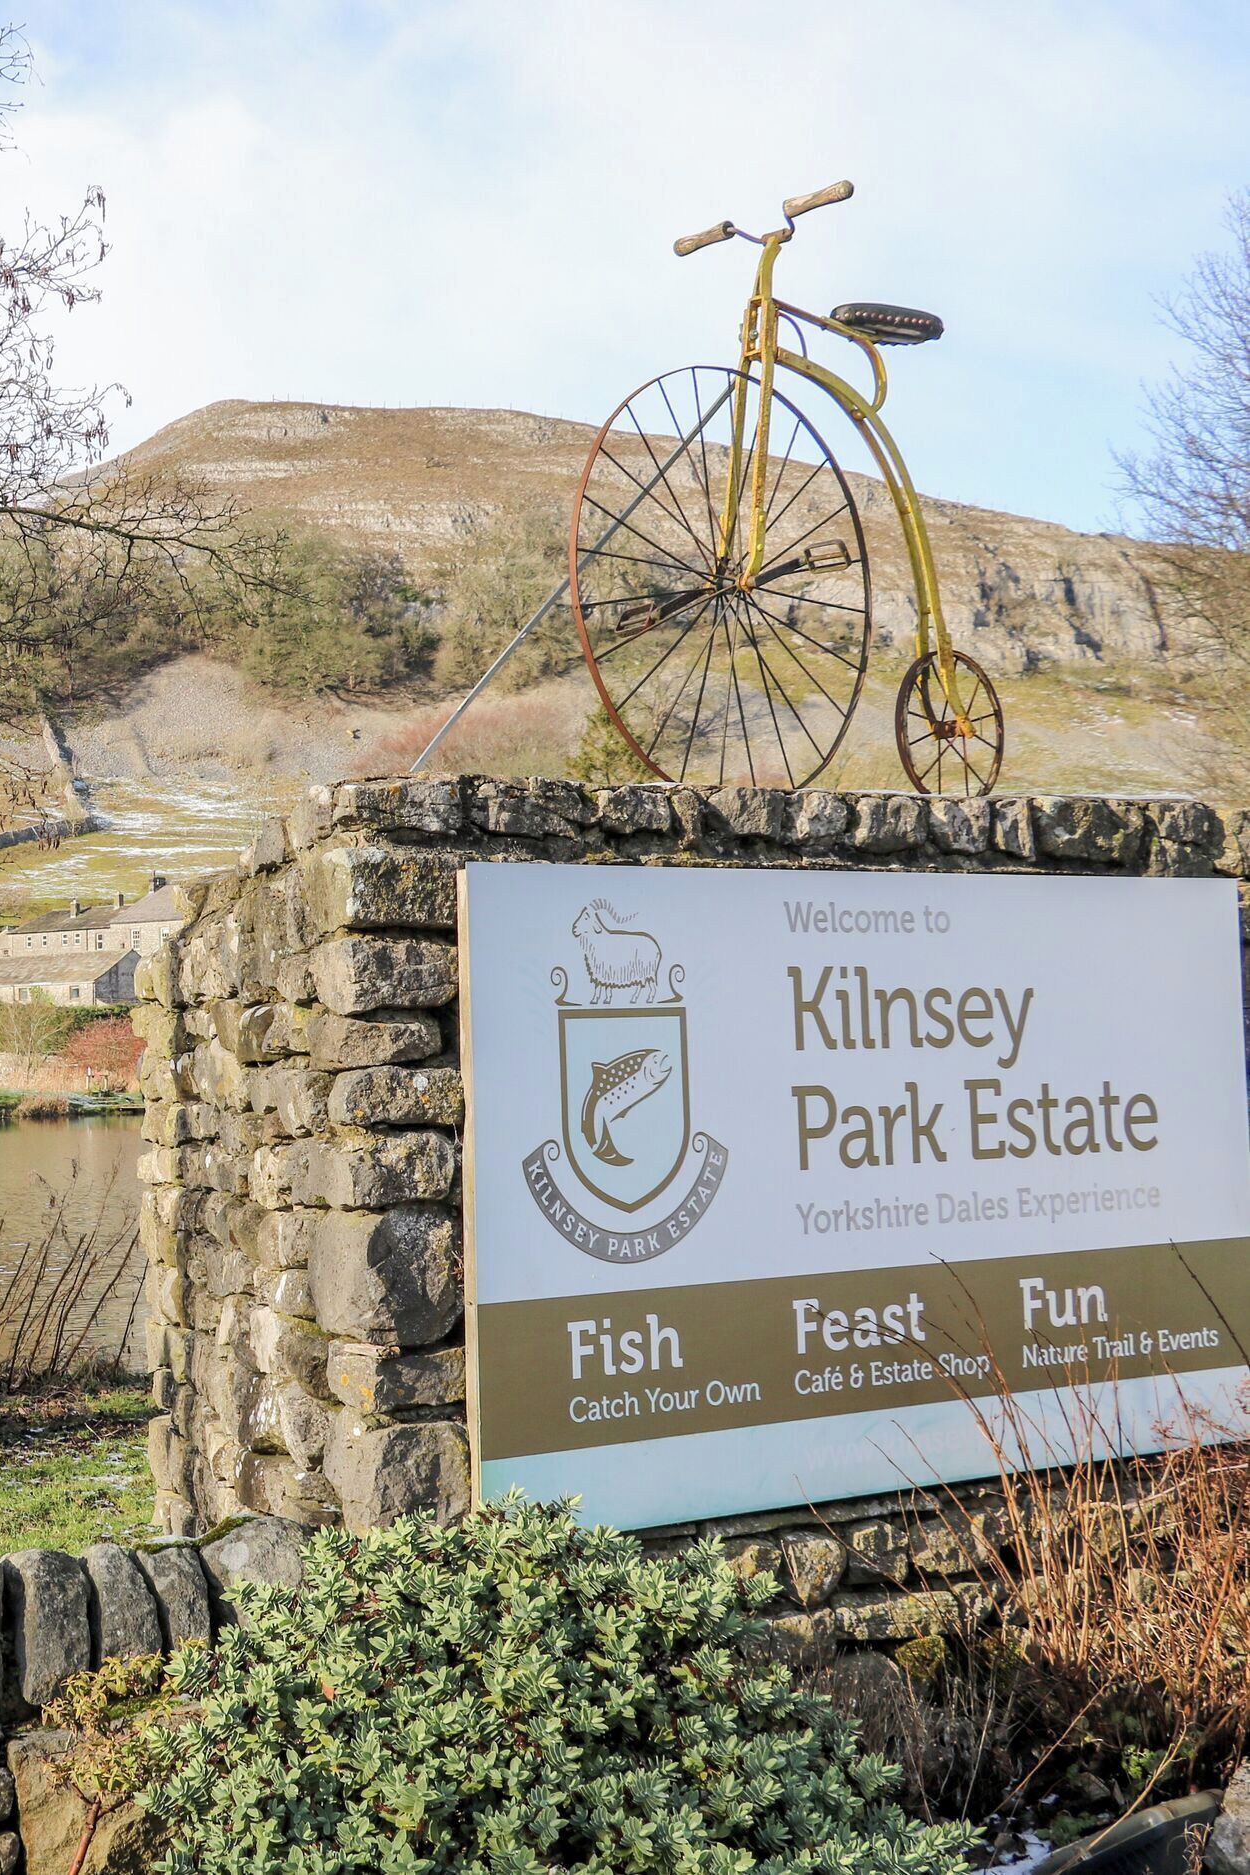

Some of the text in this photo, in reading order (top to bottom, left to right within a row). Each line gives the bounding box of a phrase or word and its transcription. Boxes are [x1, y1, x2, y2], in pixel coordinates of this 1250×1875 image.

[783, 901, 951, 933] Welcome to
[786, 965, 1035, 1069] Kilnsey
[791, 1078, 1159, 1170] Park Estate
[527, 1151, 724, 1257] KILNSEY PARK ESTATE
[795, 1183, 1161, 1235] Yorkshire Dales Experience
[792, 1292, 926, 1355] Feast
[1019, 1277, 1108, 1330] Fun
[567, 1313, 684, 1380] Fish
[1022, 1327, 1220, 1369] Nature Trail & Events
[794, 1353, 990, 1395] Café & Estate Shop
[569, 1380, 762, 1424] Catch Your Own
